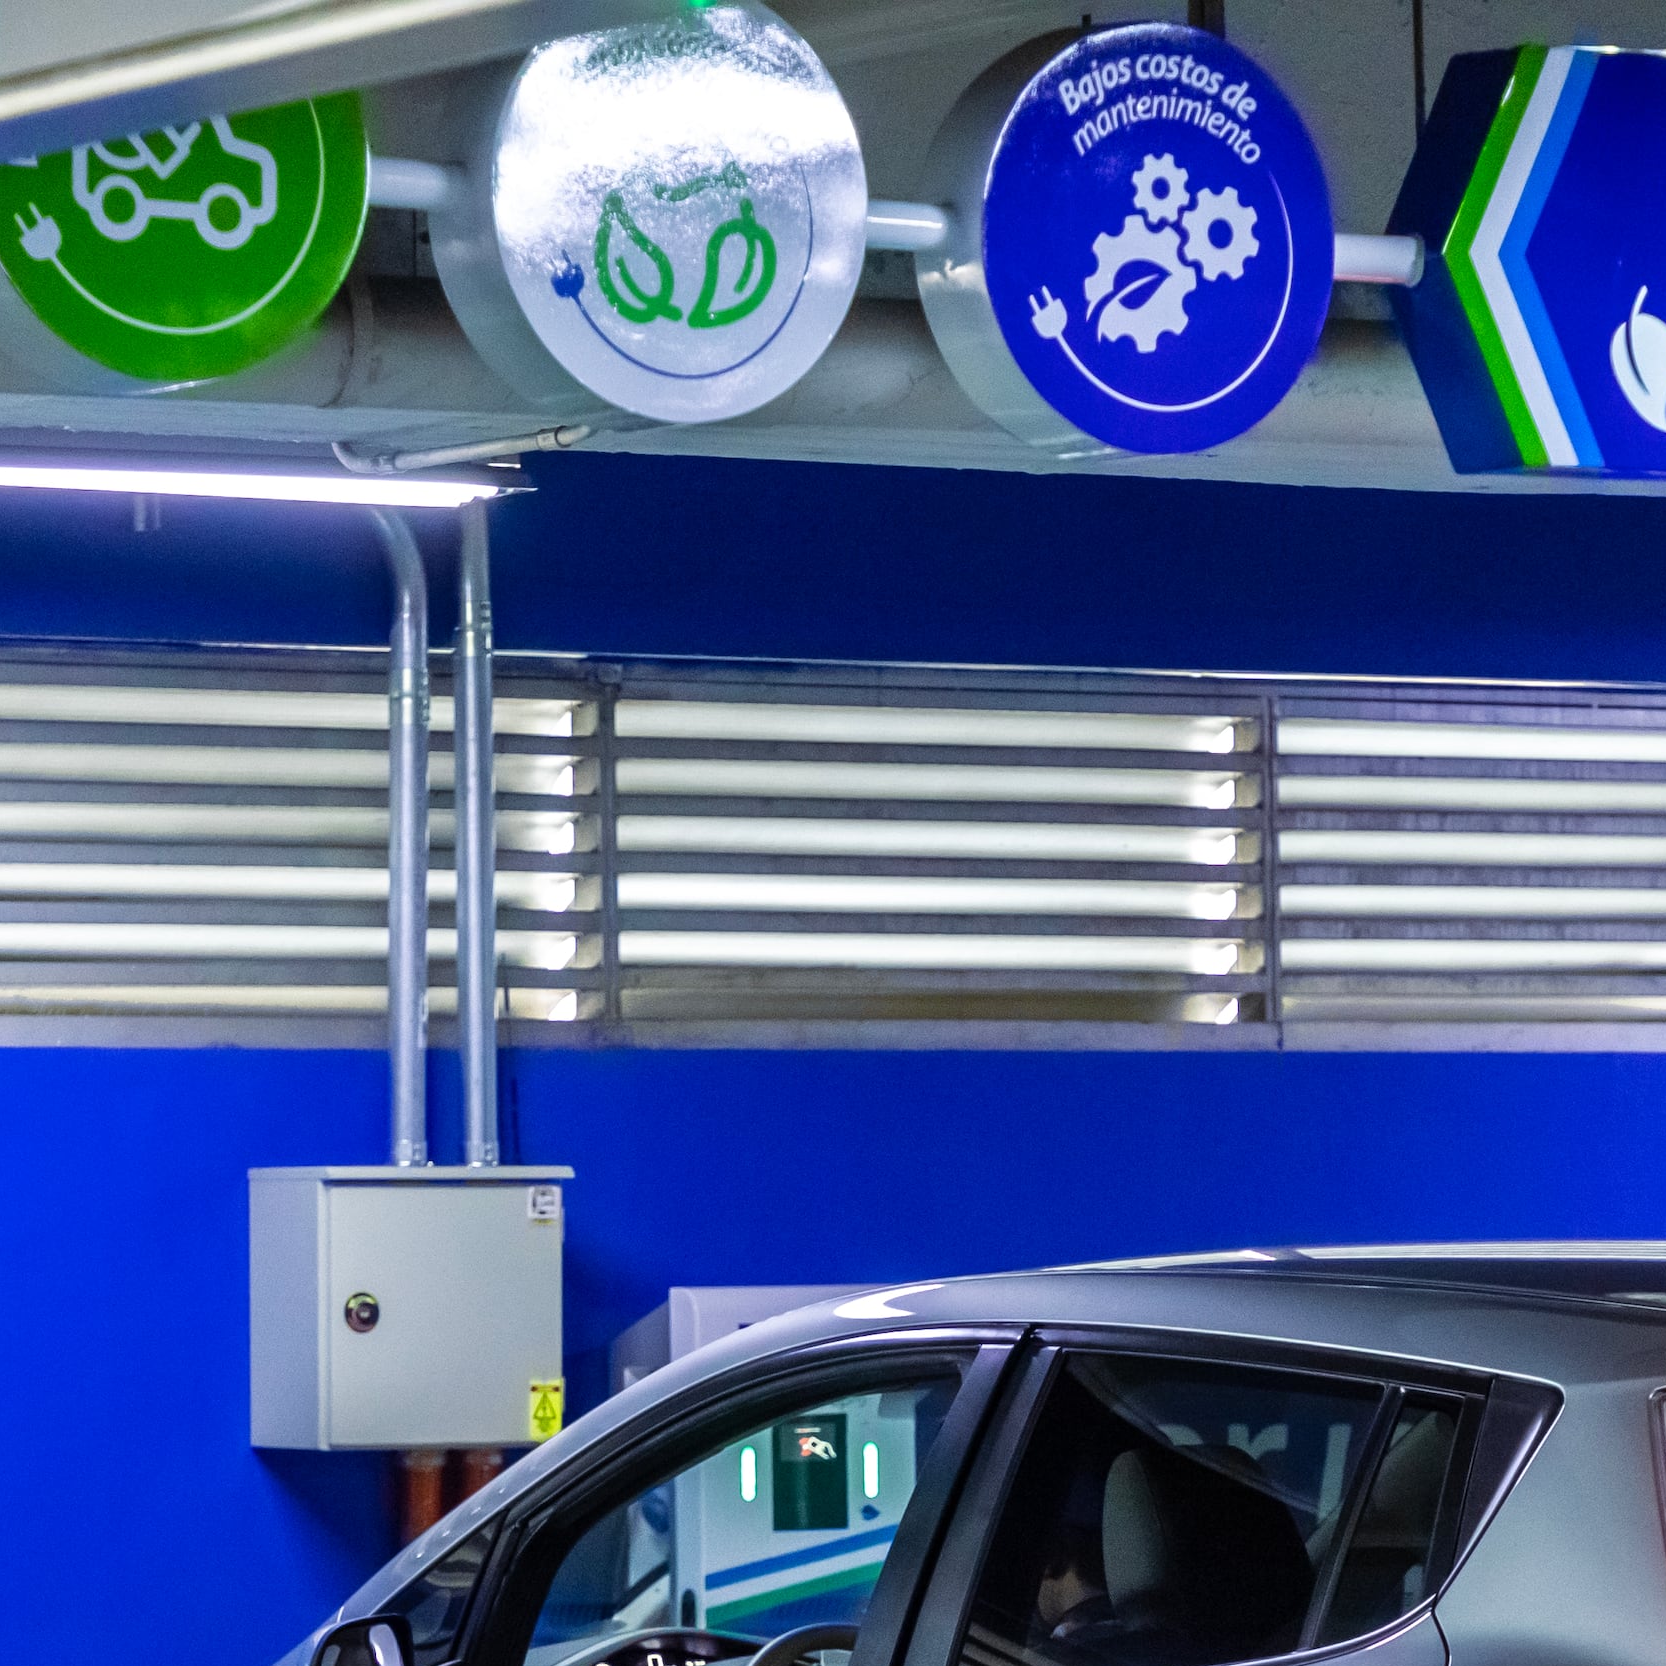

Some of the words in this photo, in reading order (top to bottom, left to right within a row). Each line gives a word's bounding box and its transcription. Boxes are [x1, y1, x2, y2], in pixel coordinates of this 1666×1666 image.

[1058, 57, 1131, 116] Bajos
[1135, 53, 1224, 95] costos
[1221, 81, 1258, 120] de
[1072, 87, 1262, 165] mantenimiento
